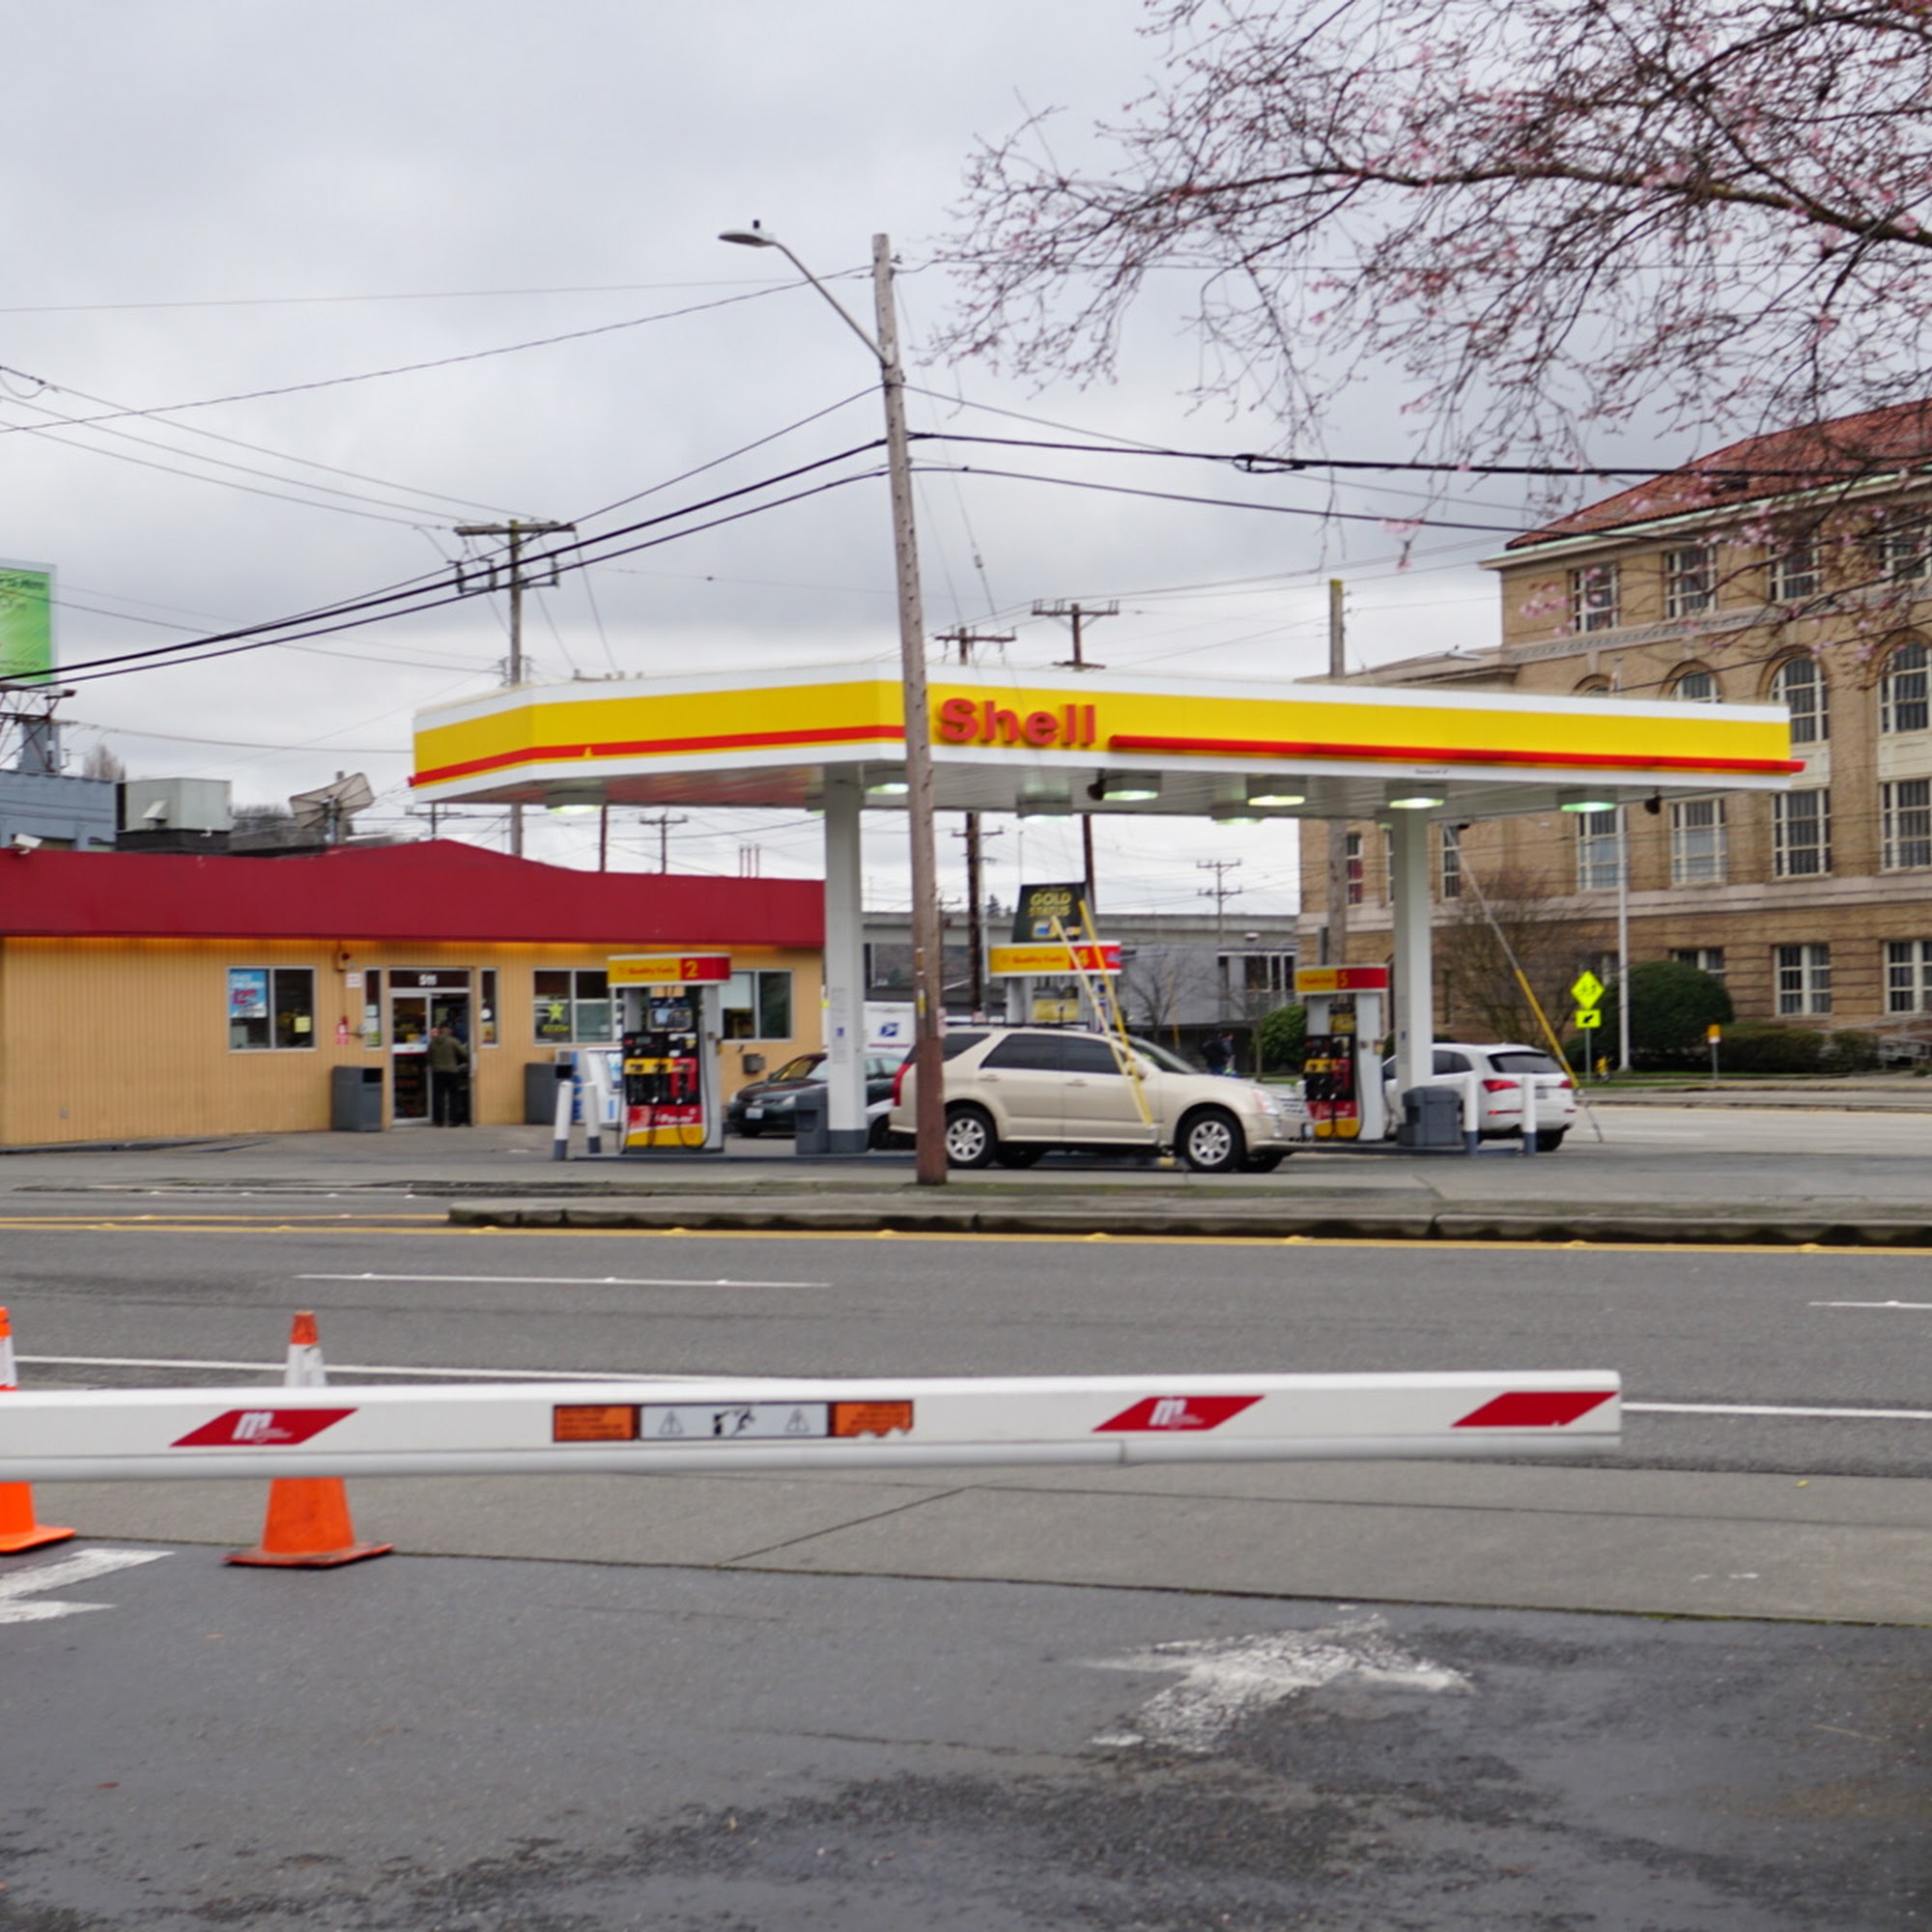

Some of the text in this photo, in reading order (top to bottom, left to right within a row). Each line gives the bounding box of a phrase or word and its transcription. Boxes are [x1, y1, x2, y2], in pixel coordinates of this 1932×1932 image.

[940, 697, 1095, 746] Shell
[1030, 892, 1072, 906] GOLD
[685, 960, 698, 978] 2
[1338, 970, 1349, 987] 5
